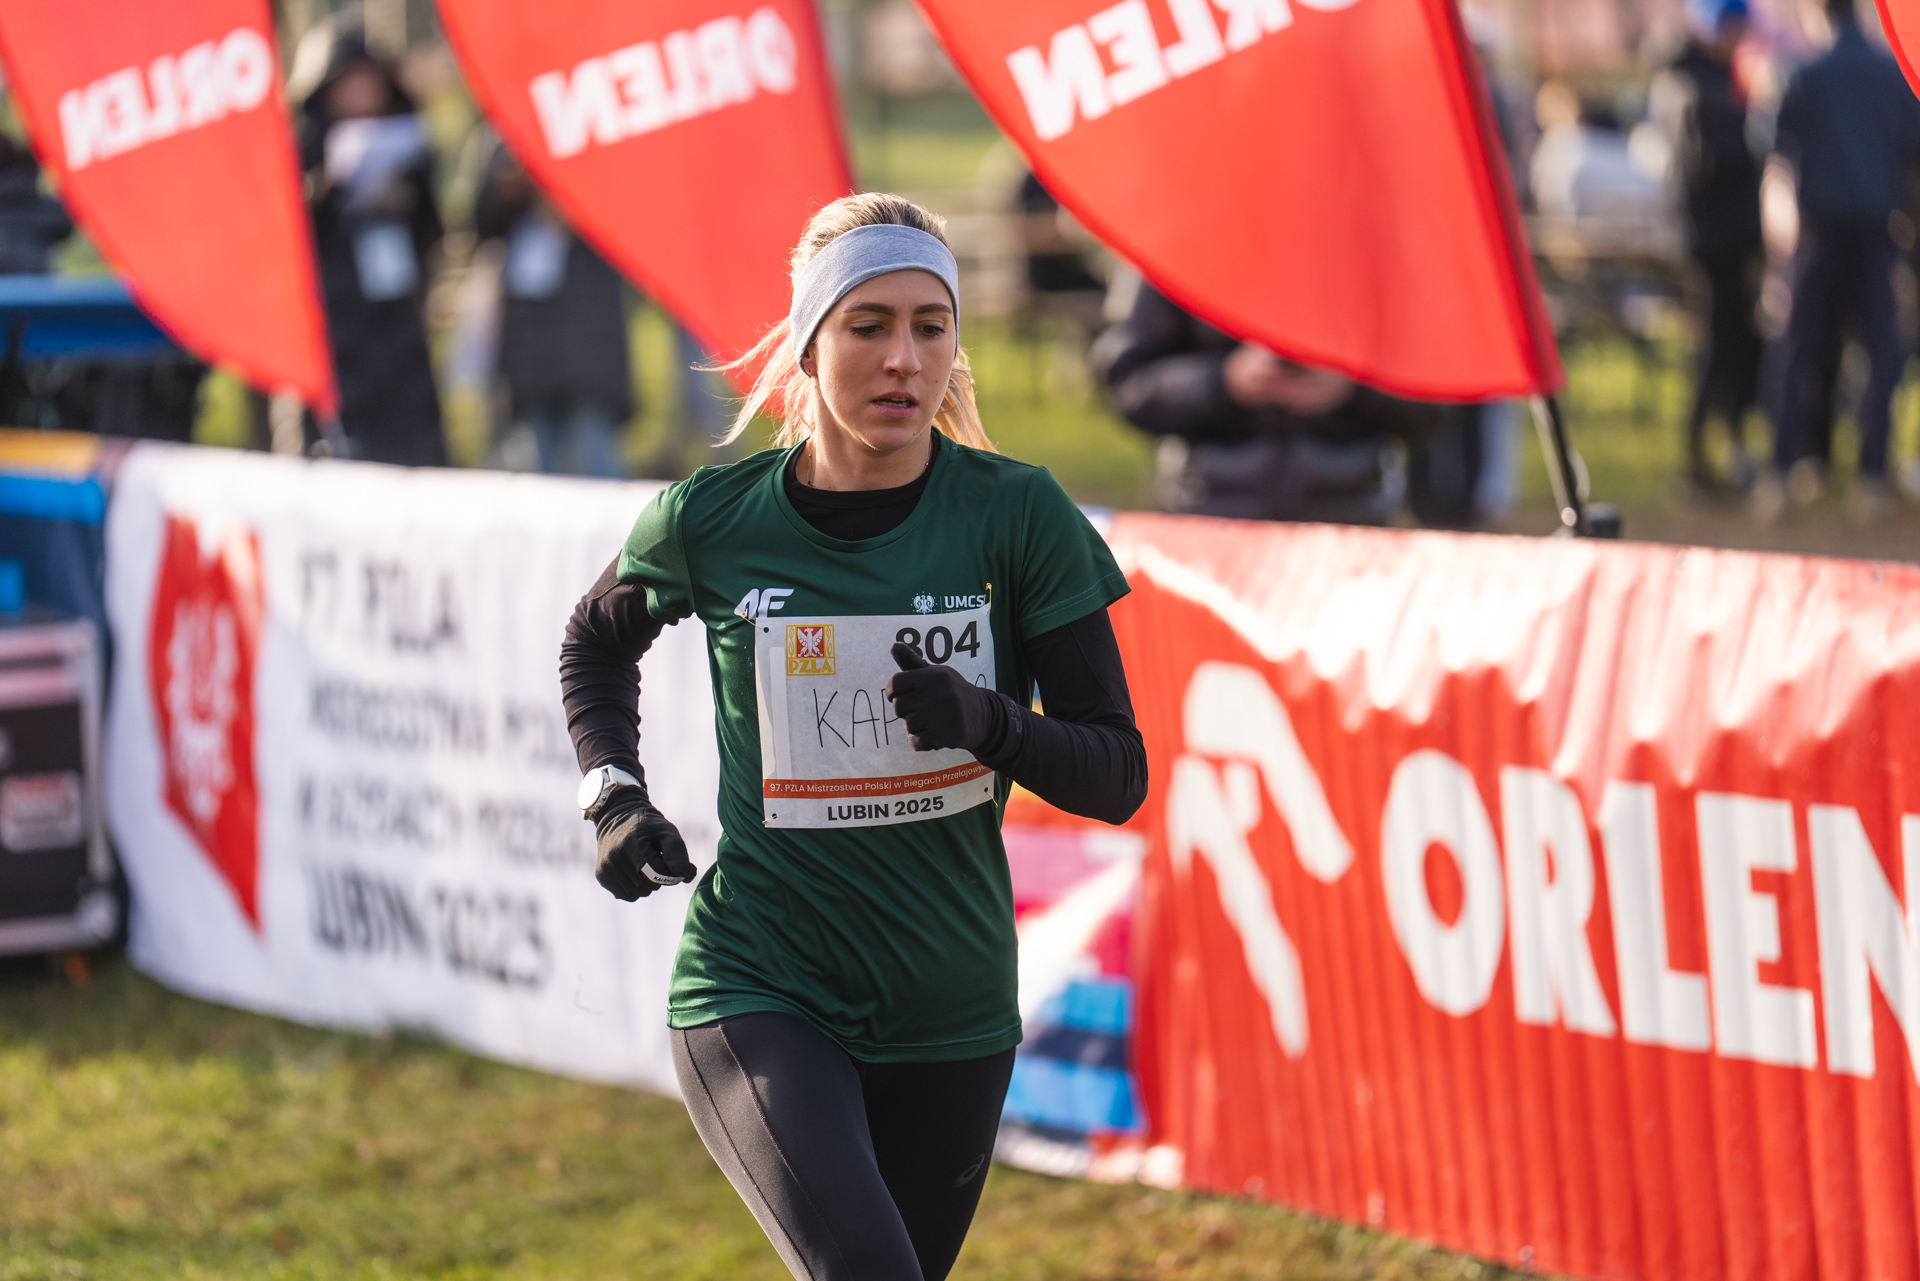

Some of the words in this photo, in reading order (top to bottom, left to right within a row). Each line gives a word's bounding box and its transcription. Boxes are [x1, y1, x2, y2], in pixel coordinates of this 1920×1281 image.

[944, 594, 985, 608] UMCS
[895, 620, 980, 664] 804
[788, 659, 833, 673] PZLA
[770, 783, 783, 792] 97.
[785, 784, 805, 792] PZLA
[807, 783, 862, 793] Mistrzostwa
[865, 781, 892, 790] Polski
[904, 775, 941, 788] Biegach
[827, 803, 889, 821] LUBIN
[894, 796, 944, 816] 2025
[1381, 748, 1920, 1085] ORLEN
